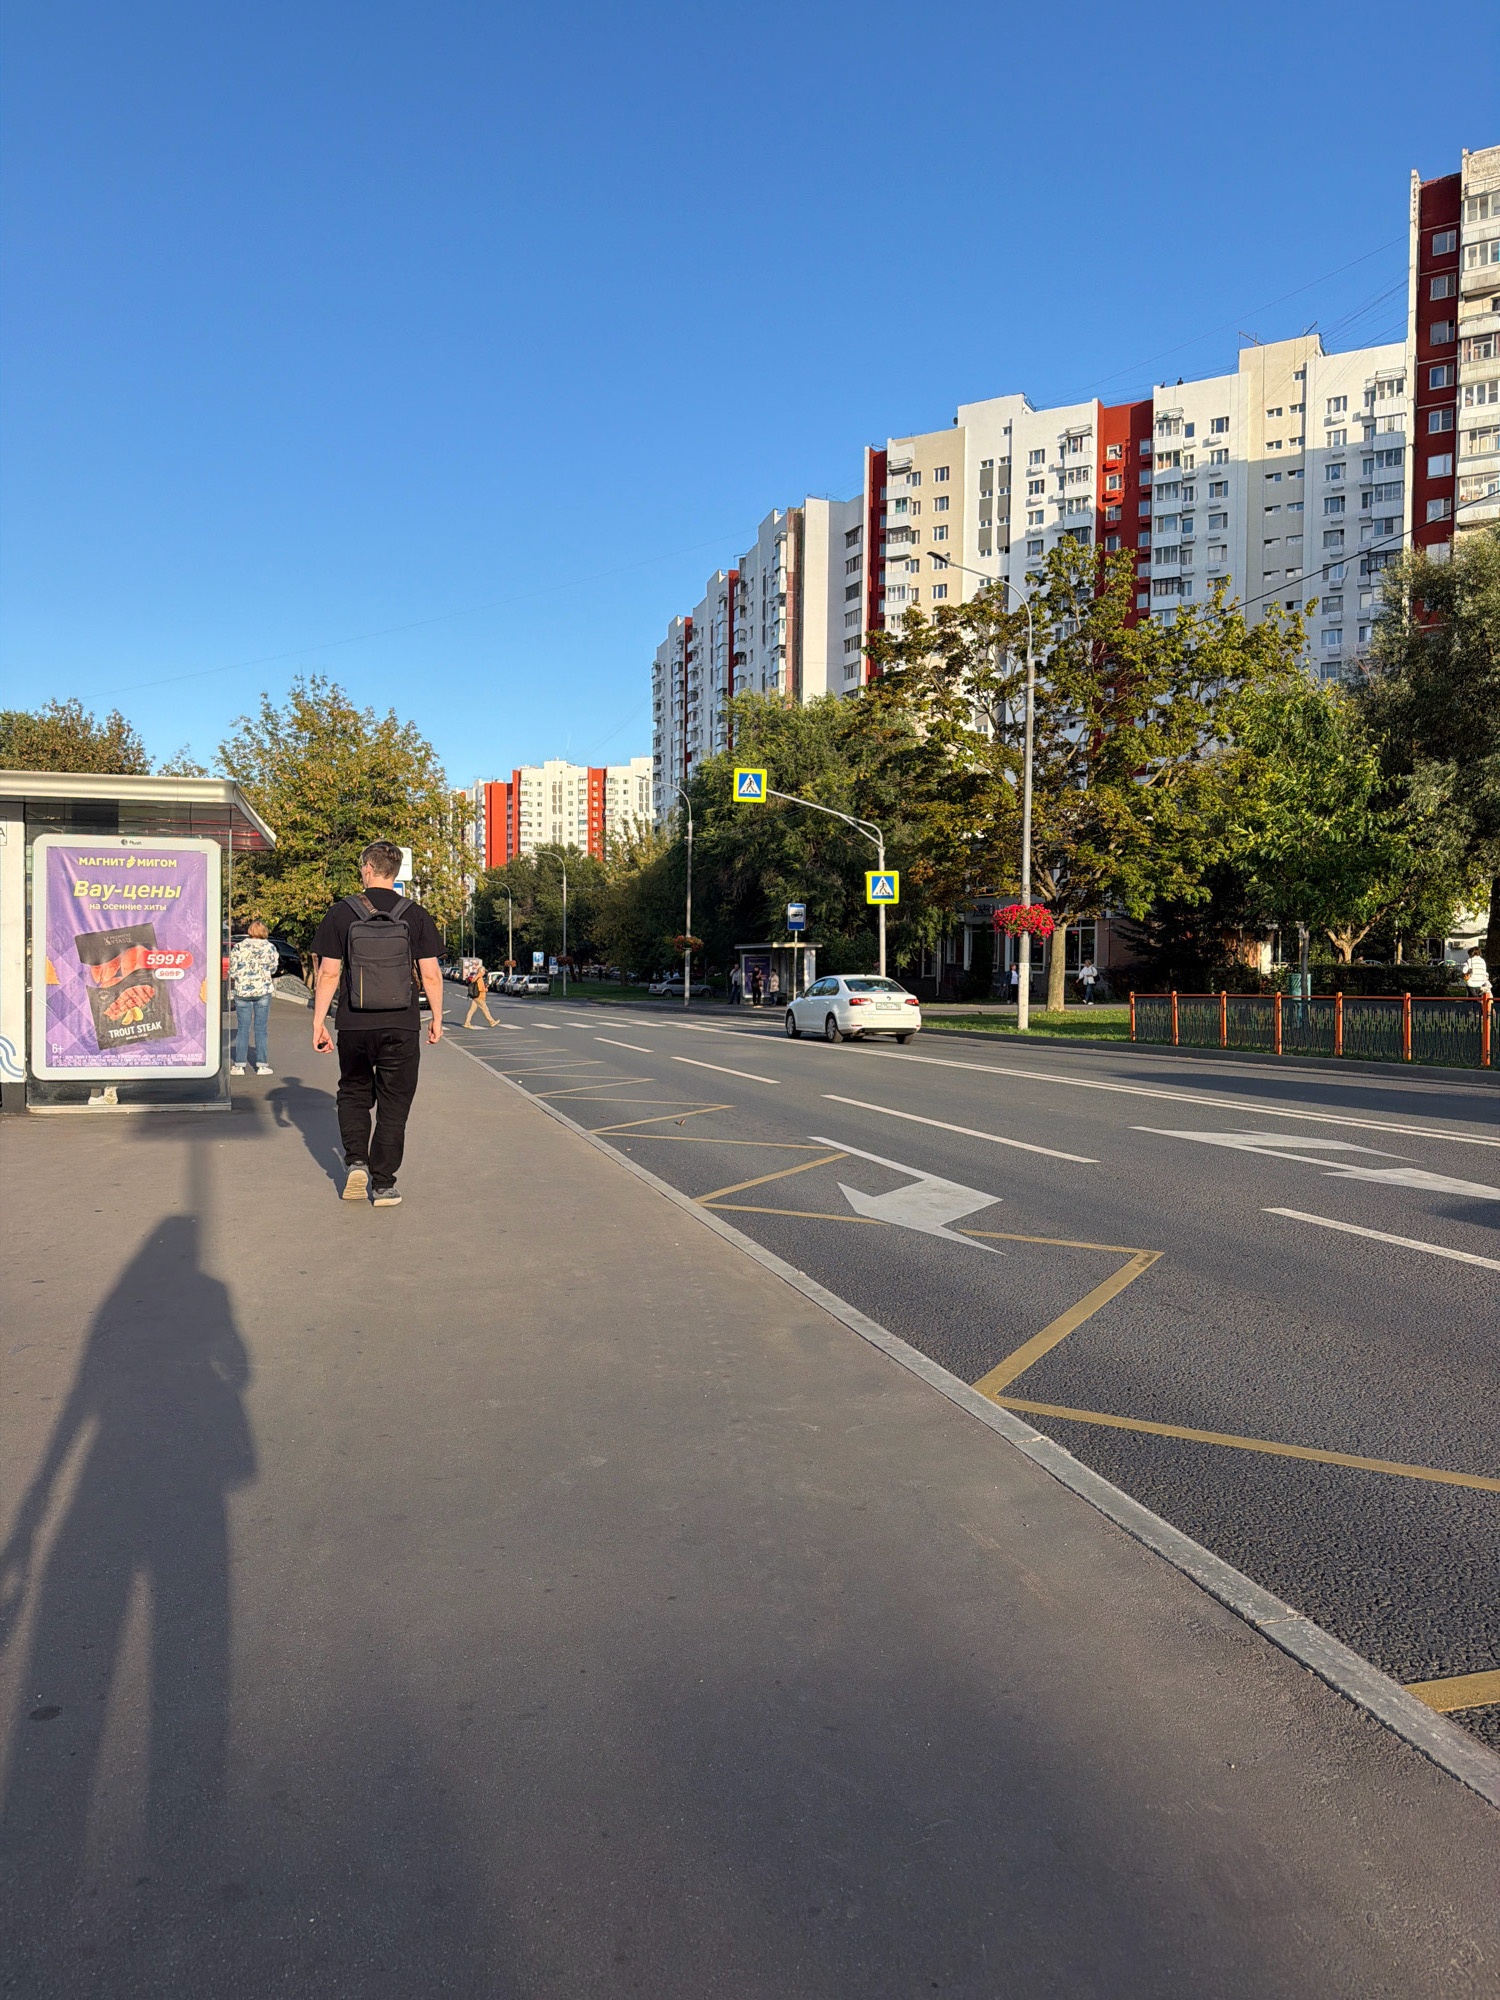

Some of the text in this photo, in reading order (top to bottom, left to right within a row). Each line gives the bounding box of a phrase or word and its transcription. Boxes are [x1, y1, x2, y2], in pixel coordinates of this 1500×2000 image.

[78, 857, 177, 868] МАГНИТ МИГОМ
[73, 880, 182, 901] Вау-цены
[144, 904, 167, 912] хиты
[108, 1026, 135, 1039] TROUT
[136, 1021, 162, 1034] STEAK
[51, 1043, 64, 1054] 6+
